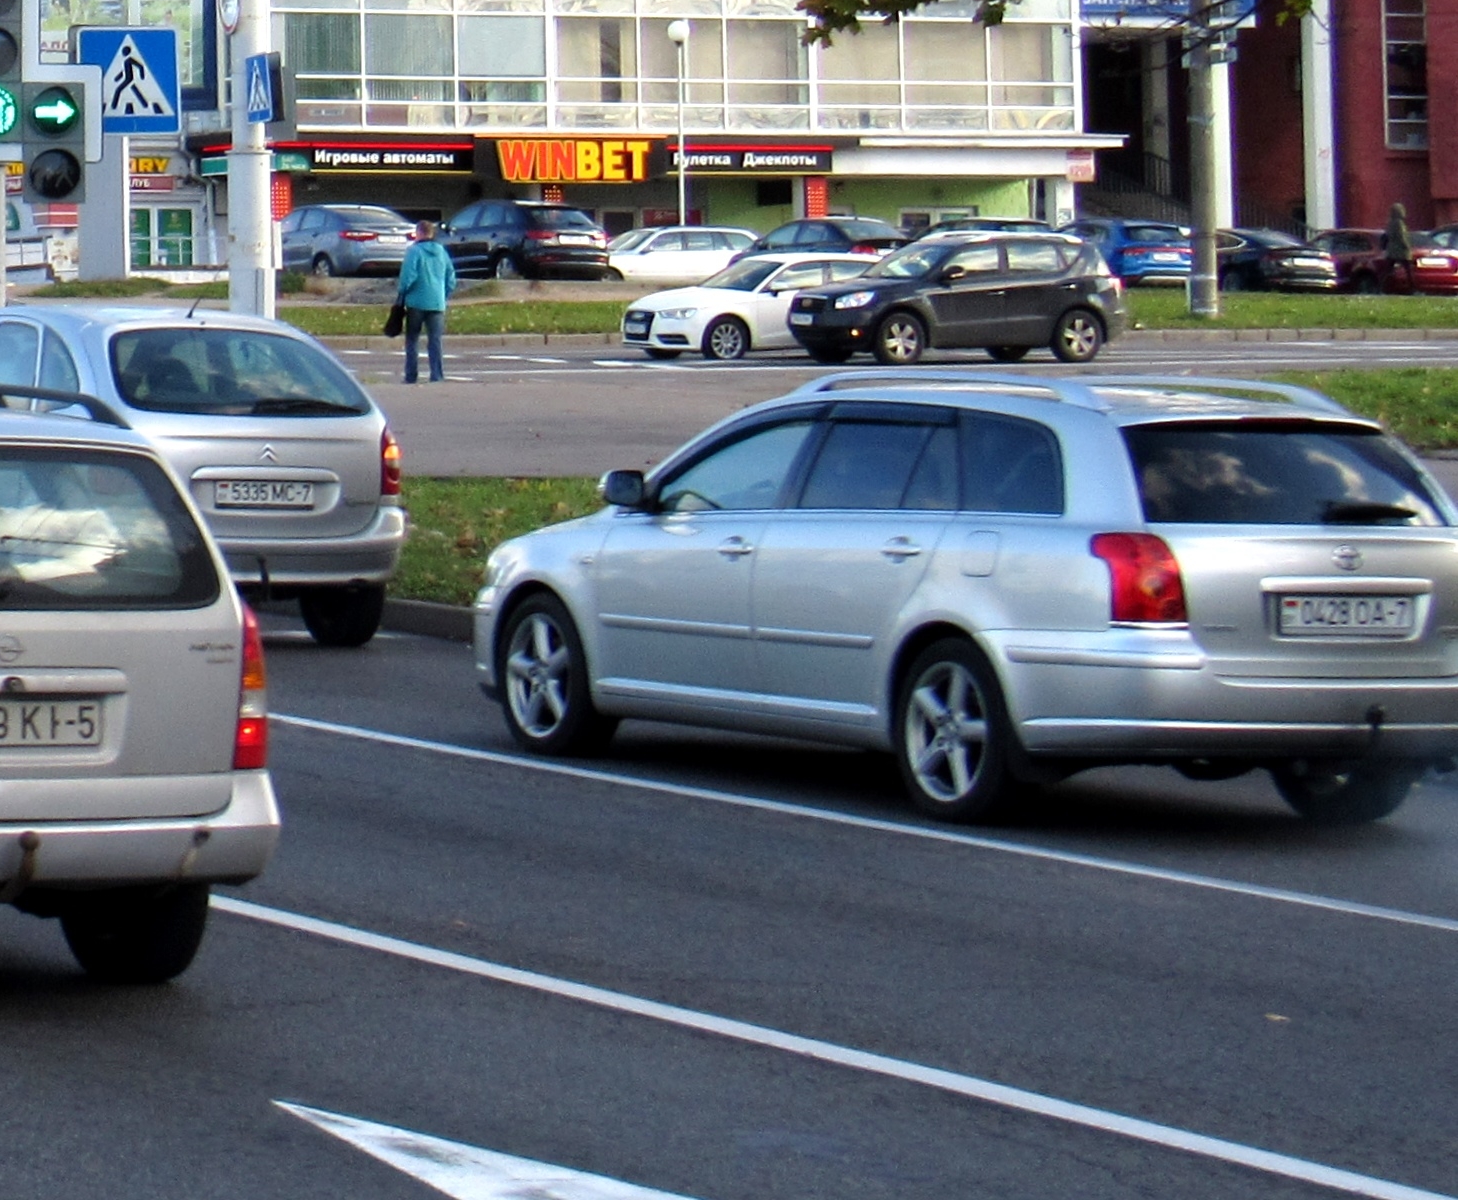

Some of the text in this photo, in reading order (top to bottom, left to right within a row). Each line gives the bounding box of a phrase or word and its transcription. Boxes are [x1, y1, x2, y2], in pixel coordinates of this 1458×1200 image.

[315, 150, 454, 166] Игровые автоматы
[497, 140, 650, 181] WINBET
[674, 151, 817, 167] Рулетка Джекпоты
[231, 484, 311, 502] 5335 MC-7
[1302, 601, 1406, 625] 0428 OA-7
